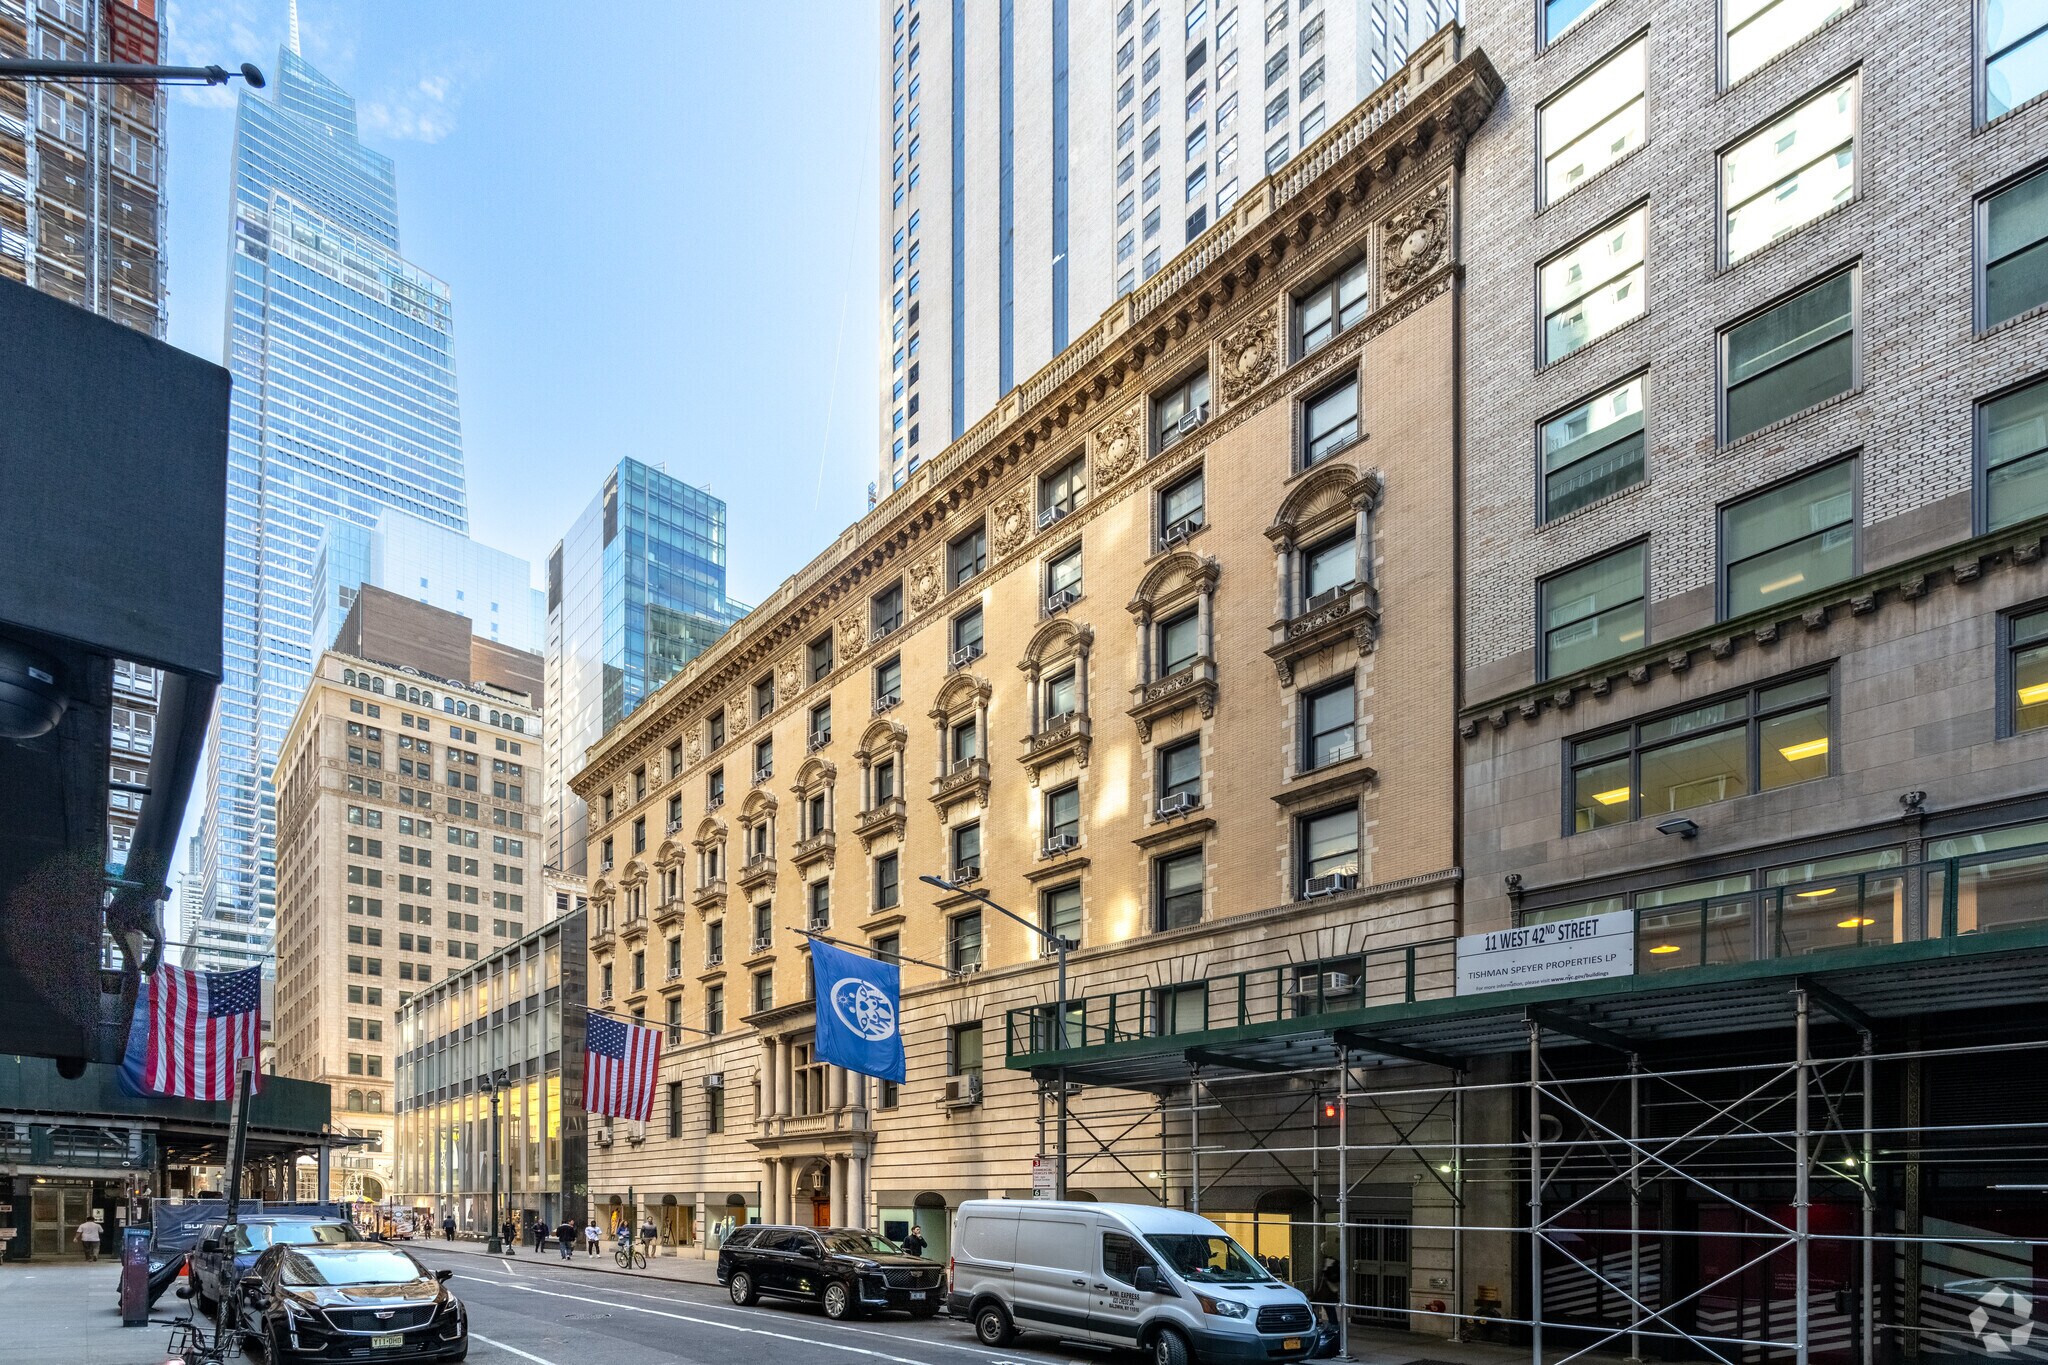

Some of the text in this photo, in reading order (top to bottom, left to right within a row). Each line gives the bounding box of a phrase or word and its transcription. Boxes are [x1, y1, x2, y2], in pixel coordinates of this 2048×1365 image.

[1485, 919, 1599, 951] 11 WEST 42ND STREET
[1468, 954, 1617, 979] TISHMAN SPEYER PROPERTIES LP
[1551, 971, 1609, 982] www.nyc.gov/buildings
[1121, 1291, 1140, 1301] EXPRESS
